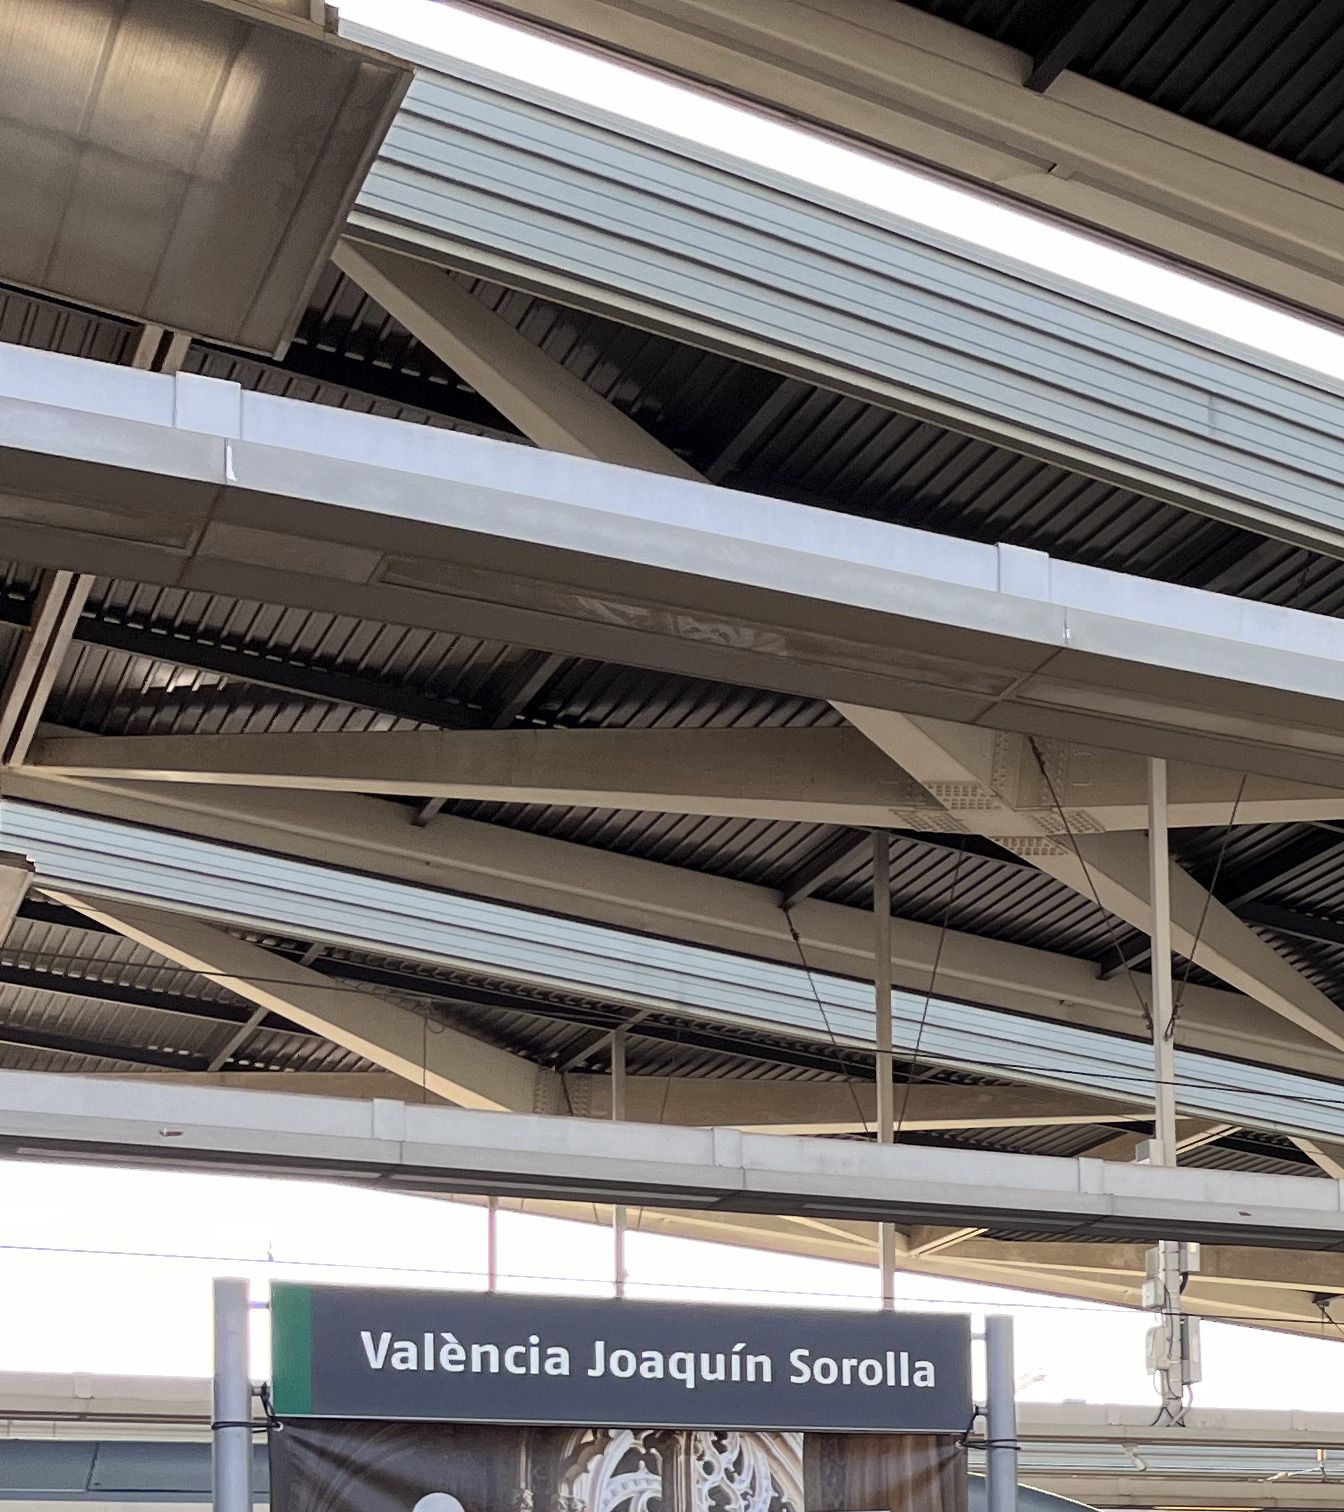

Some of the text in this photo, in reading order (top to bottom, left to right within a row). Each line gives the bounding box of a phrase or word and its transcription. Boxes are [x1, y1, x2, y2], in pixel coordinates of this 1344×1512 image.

[360, 1331, 936, 1389] València Joaquín Sorolla
